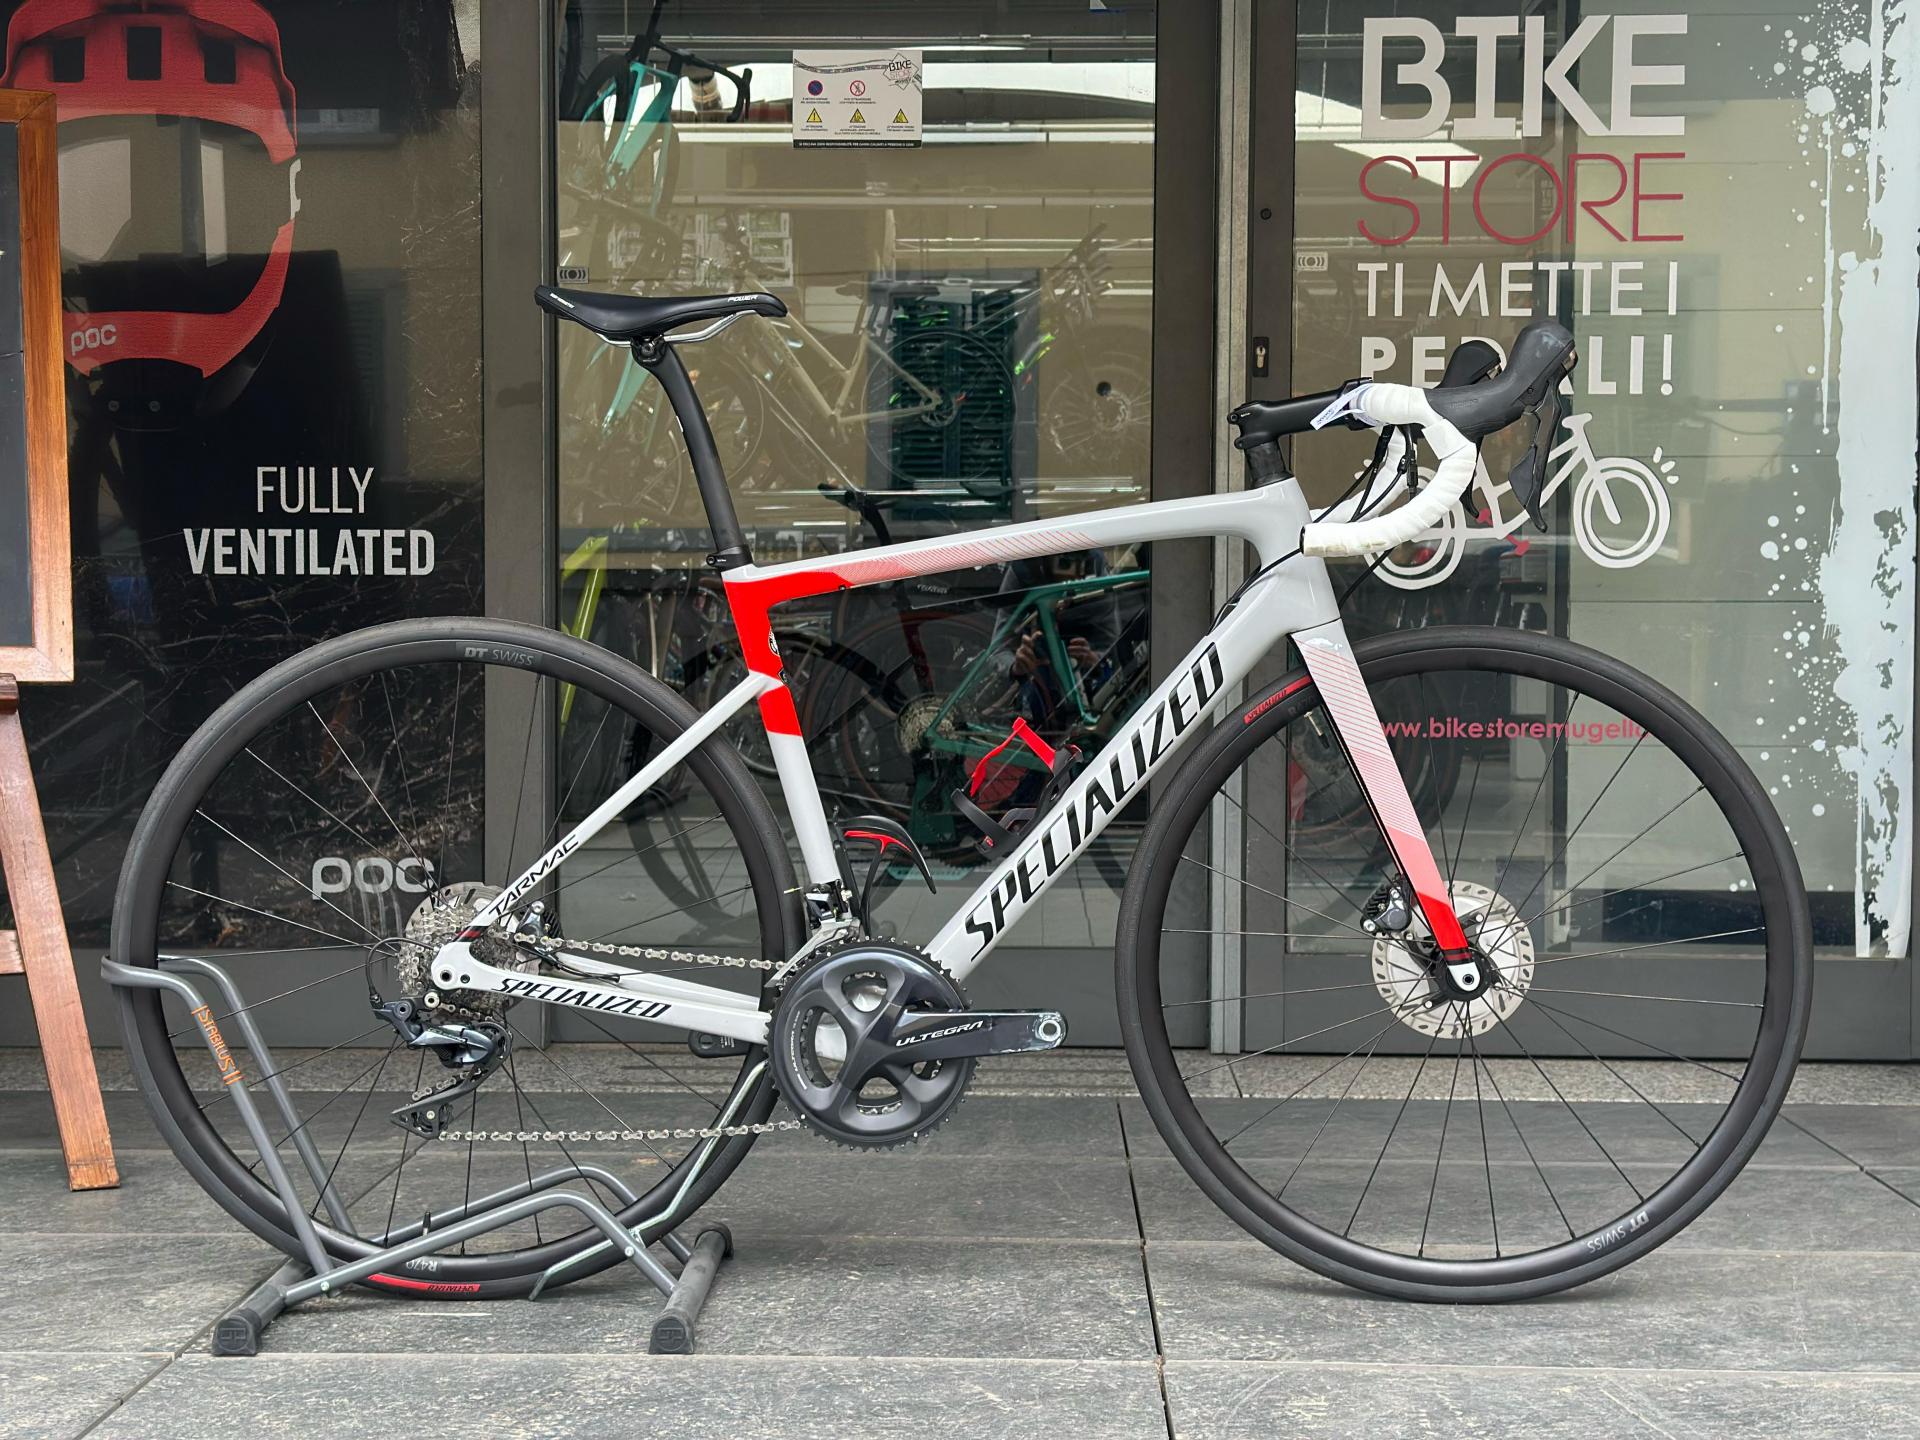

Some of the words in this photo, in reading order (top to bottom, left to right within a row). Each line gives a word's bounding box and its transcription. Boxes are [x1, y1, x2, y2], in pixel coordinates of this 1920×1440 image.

[889, 60, 911, 71] BIKE
[1361, 14, 1687, 139] BIKE
[1357, 152, 1686, 246] STORE
[1357, 262, 1404, 317] TI
[1428, 261, 1643, 317] METTE
[1668, 261, 1678, 316] I
[1360, 334, 1673, 396] PELI!
[257, 466, 374, 514] FULLY
[183, 528, 435, 576] VENTILATED
[464, 647, 488, 659] DT
[492, 649, 534, 666] SWISS
[965, 641, 1224, 962] SPECIALIZED
[488, 834, 580, 918] TARMAC
[491, 978, 672, 1019] SPECIALIZED
[895, 1021, 983, 1047] ULTEGRA
[1587, 1225, 1626, 1254] SWISS
